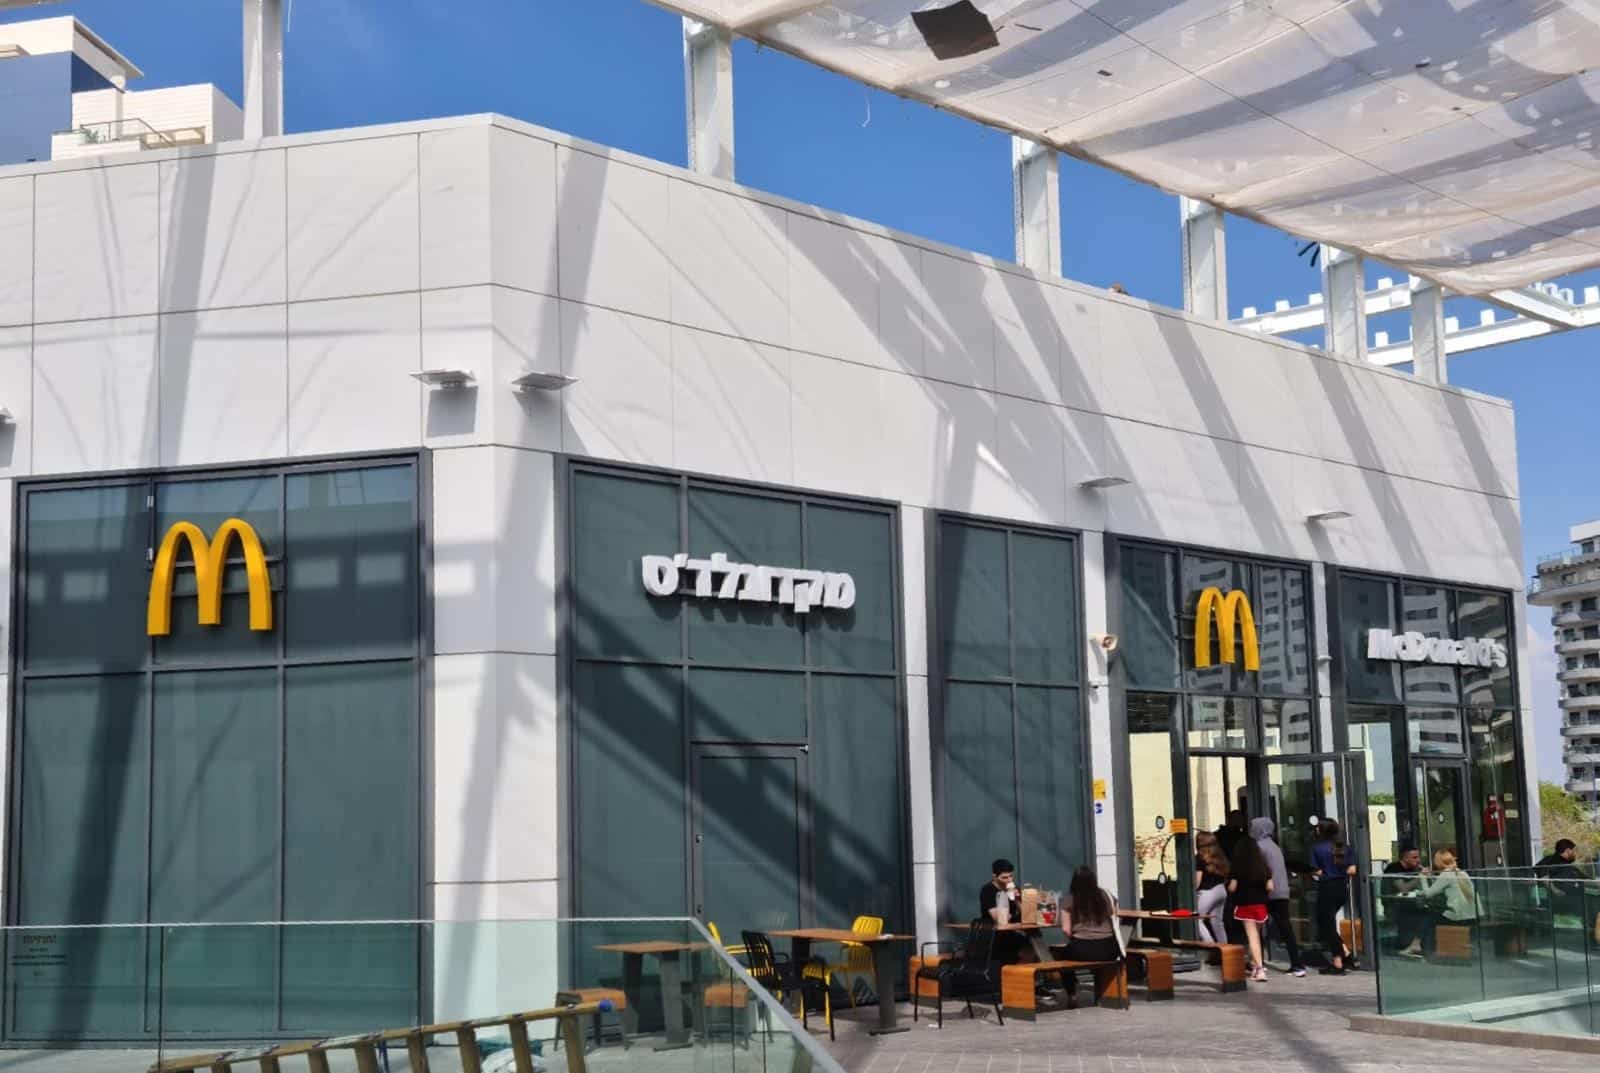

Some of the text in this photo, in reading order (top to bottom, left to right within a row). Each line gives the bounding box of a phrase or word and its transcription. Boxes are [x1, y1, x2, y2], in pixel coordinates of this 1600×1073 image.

[146, 517, 273, 636] M
[1195, 586, 1260, 672] M
[1367, 627, 1508, 668] McDonald's
